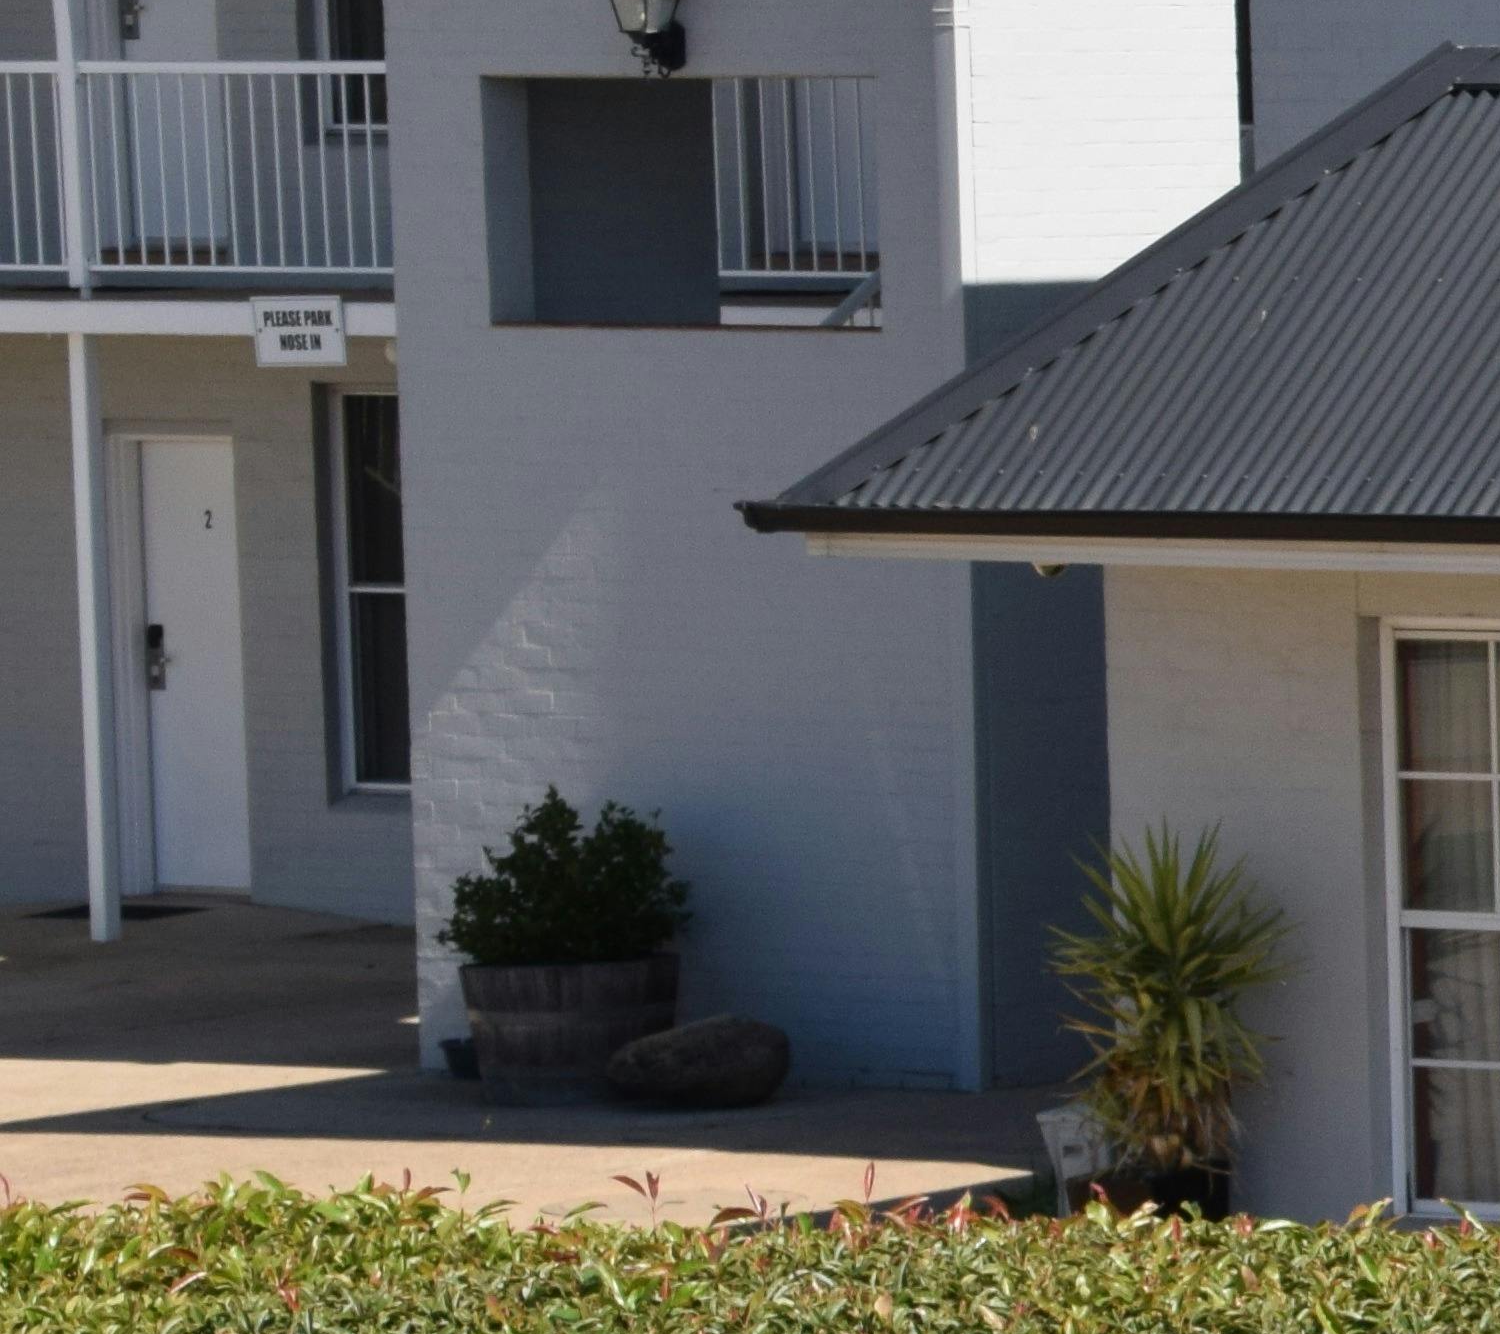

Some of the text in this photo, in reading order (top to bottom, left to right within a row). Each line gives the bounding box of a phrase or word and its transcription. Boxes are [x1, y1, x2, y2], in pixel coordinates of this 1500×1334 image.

[263, 309, 333, 327] PLEASE PARK
[280, 333, 322, 350] NOSE IN
[204, 509, 212, 529] 2
